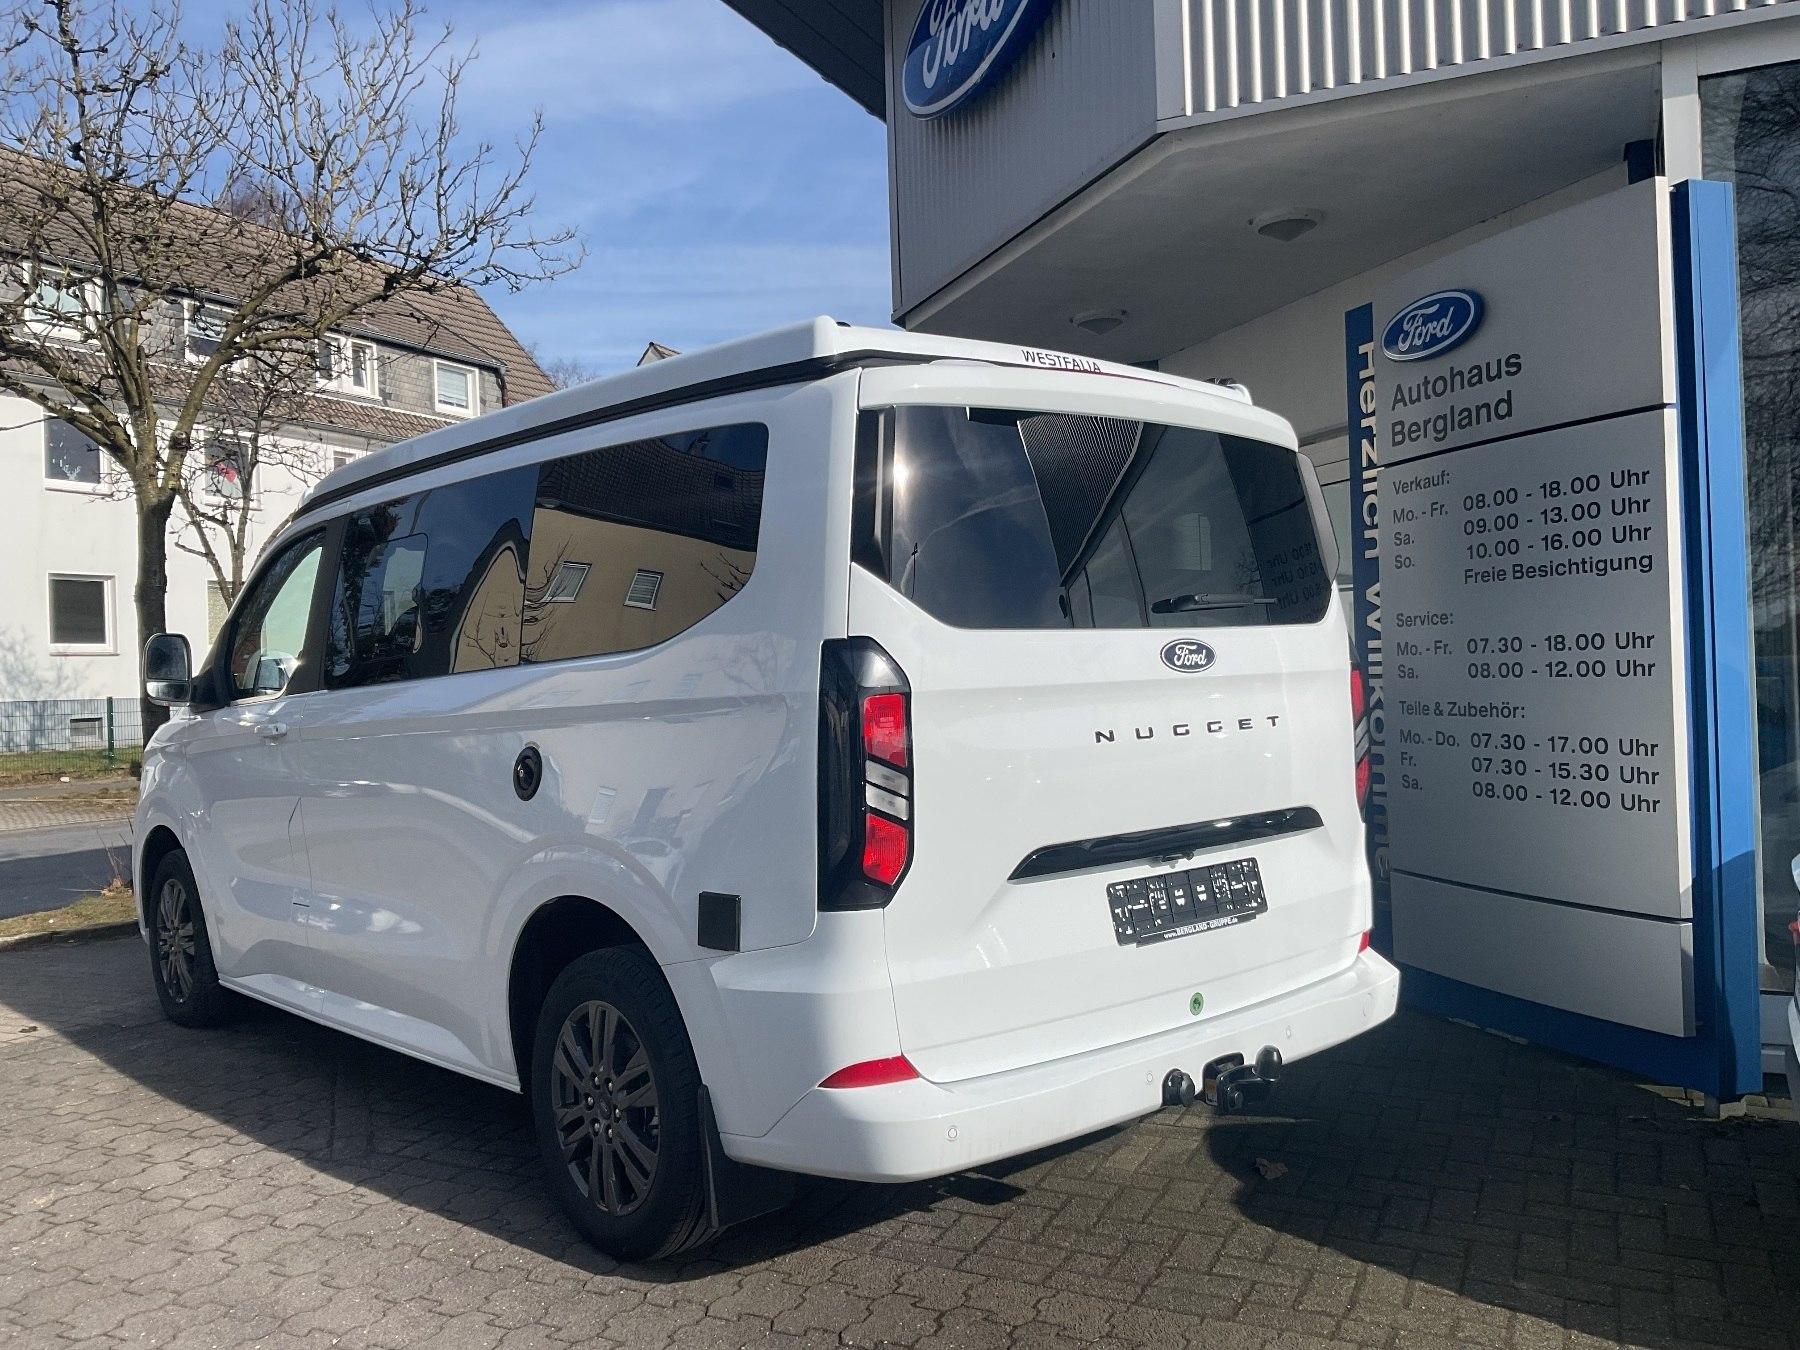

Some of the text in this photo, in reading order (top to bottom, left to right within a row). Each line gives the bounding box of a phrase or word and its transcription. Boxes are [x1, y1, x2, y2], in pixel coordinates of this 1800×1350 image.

[1398, 303, 1454, 352] Ford
[1020, 350, 1102, 373] WESTFALIA
[1391, 353, 1523, 411] Autohaus
[1391, 390, 1513, 447] Bergland
[1393, 469, 1450, 495] Verkauf:
[1393, 508, 1418, 524] Mo.
[1430, 501, 1449, 517] Fr.
[1463, 487, 1518, 511] 08.00
[1539, 474, 1600, 499] 18.00
[1610, 469, 1650, 489] Uhr
[1393, 531, 1415, 546] Sa.
[1463, 513, 1519, 535] 09.00
[1540, 502, 1601, 525] 13.00
[1611, 496, 1651, 516] Uhr
[1394, 554, 1415, 569] So.
[1467, 539, 1520, 560] 10.00
[1540, 528, 1602, 551] 16.00
[1611, 524, 1652, 544] Uhr
[1464, 555, 1653, 585] Freie Besichtigung
[1396, 611, 1454, 627] Service:
[1173, 644, 1208, 667] Ford
[1396, 641, 1422, 656] Mo.
[1434, 640, 1452, 655] Fr.
[1466, 636, 1523, 654] 07.30
[1545, 632, 1605, 651] 18.00
[1615, 631, 1655, 650] Uhr
[1397, 664, 1419, 679] Sa.
[1467, 662, 1523, 678] 08.00
[1545, 659, 1606, 678] 12.00
[1615, 658, 1656, 677] Uhr
[1399, 701, 1526, 718] Teile & Zubehör:
[1095, 715, 1280, 744] NUGGET
[1365, 581, 1391, 903] Willkomme
[1400, 729, 1424, 745] Mo.
[1435, 731, 1460, 747] Do.
[1470, 732, 1525, 750] 07.30
[1547, 736, 1609, 755] 17.00
[1618, 738, 1658, 757] Uhr
[1401, 752, 1417, 767] Fr.
[1471, 756, 1527, 776] 07.30
[1548, 762, 1610, 782] 15.30
[1619, 766, 1660, 785] Uhr
[1401, 774, 1423, 791] Sa.
[1472, 781, 1527, 802] 08.00
[1549, 788, 1611, 809] 12.00
[1620, 793, 1661, 812] Uhr
